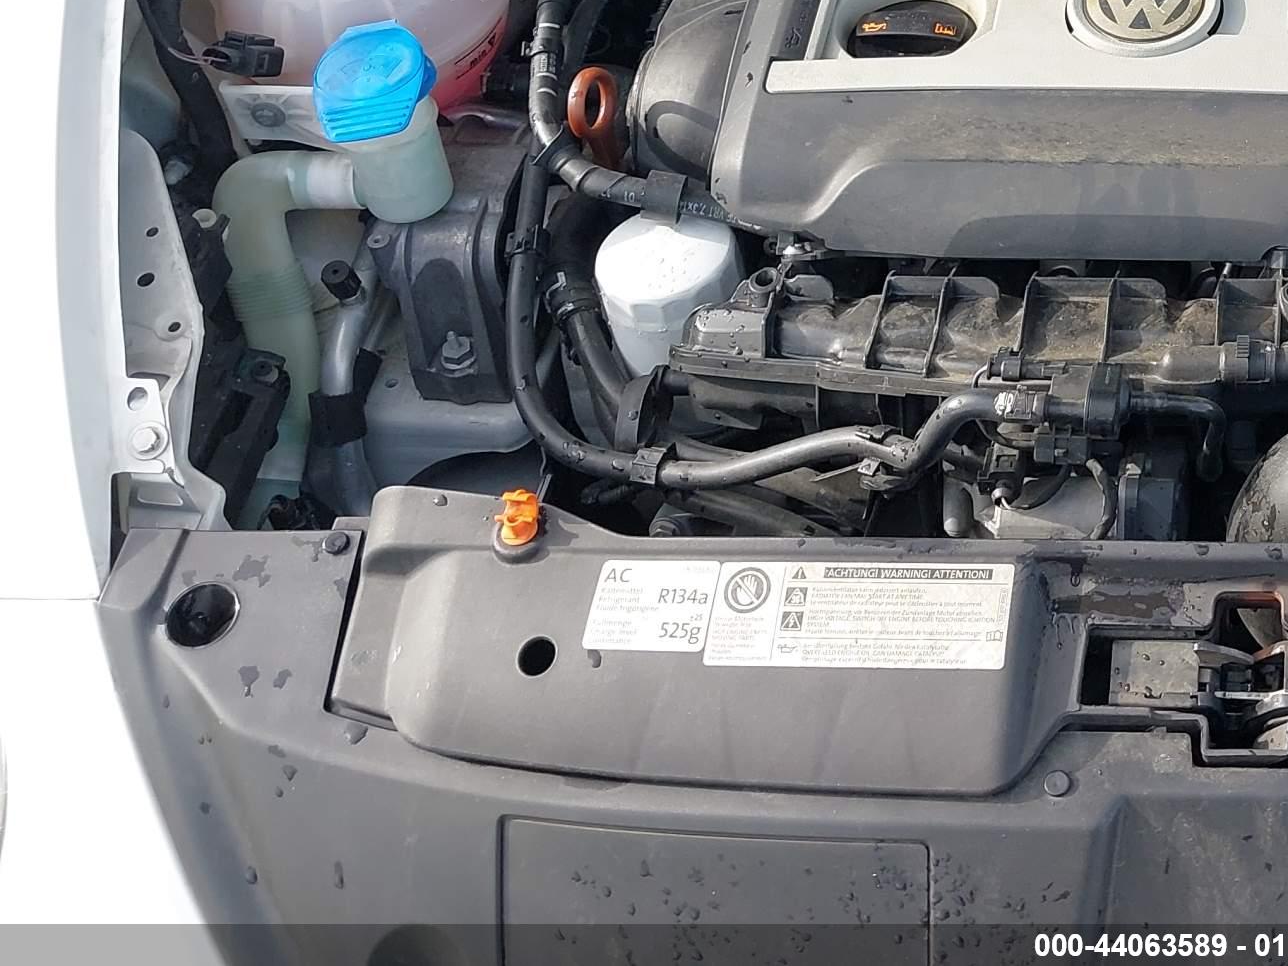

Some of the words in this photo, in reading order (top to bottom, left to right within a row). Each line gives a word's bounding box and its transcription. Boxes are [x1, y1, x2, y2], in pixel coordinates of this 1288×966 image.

[470, 49, 488, 68] min
[604, 568, 633, 583] AC
[658, 588, 709, 605] R134a
[658, 622, 702, 645] 525g
